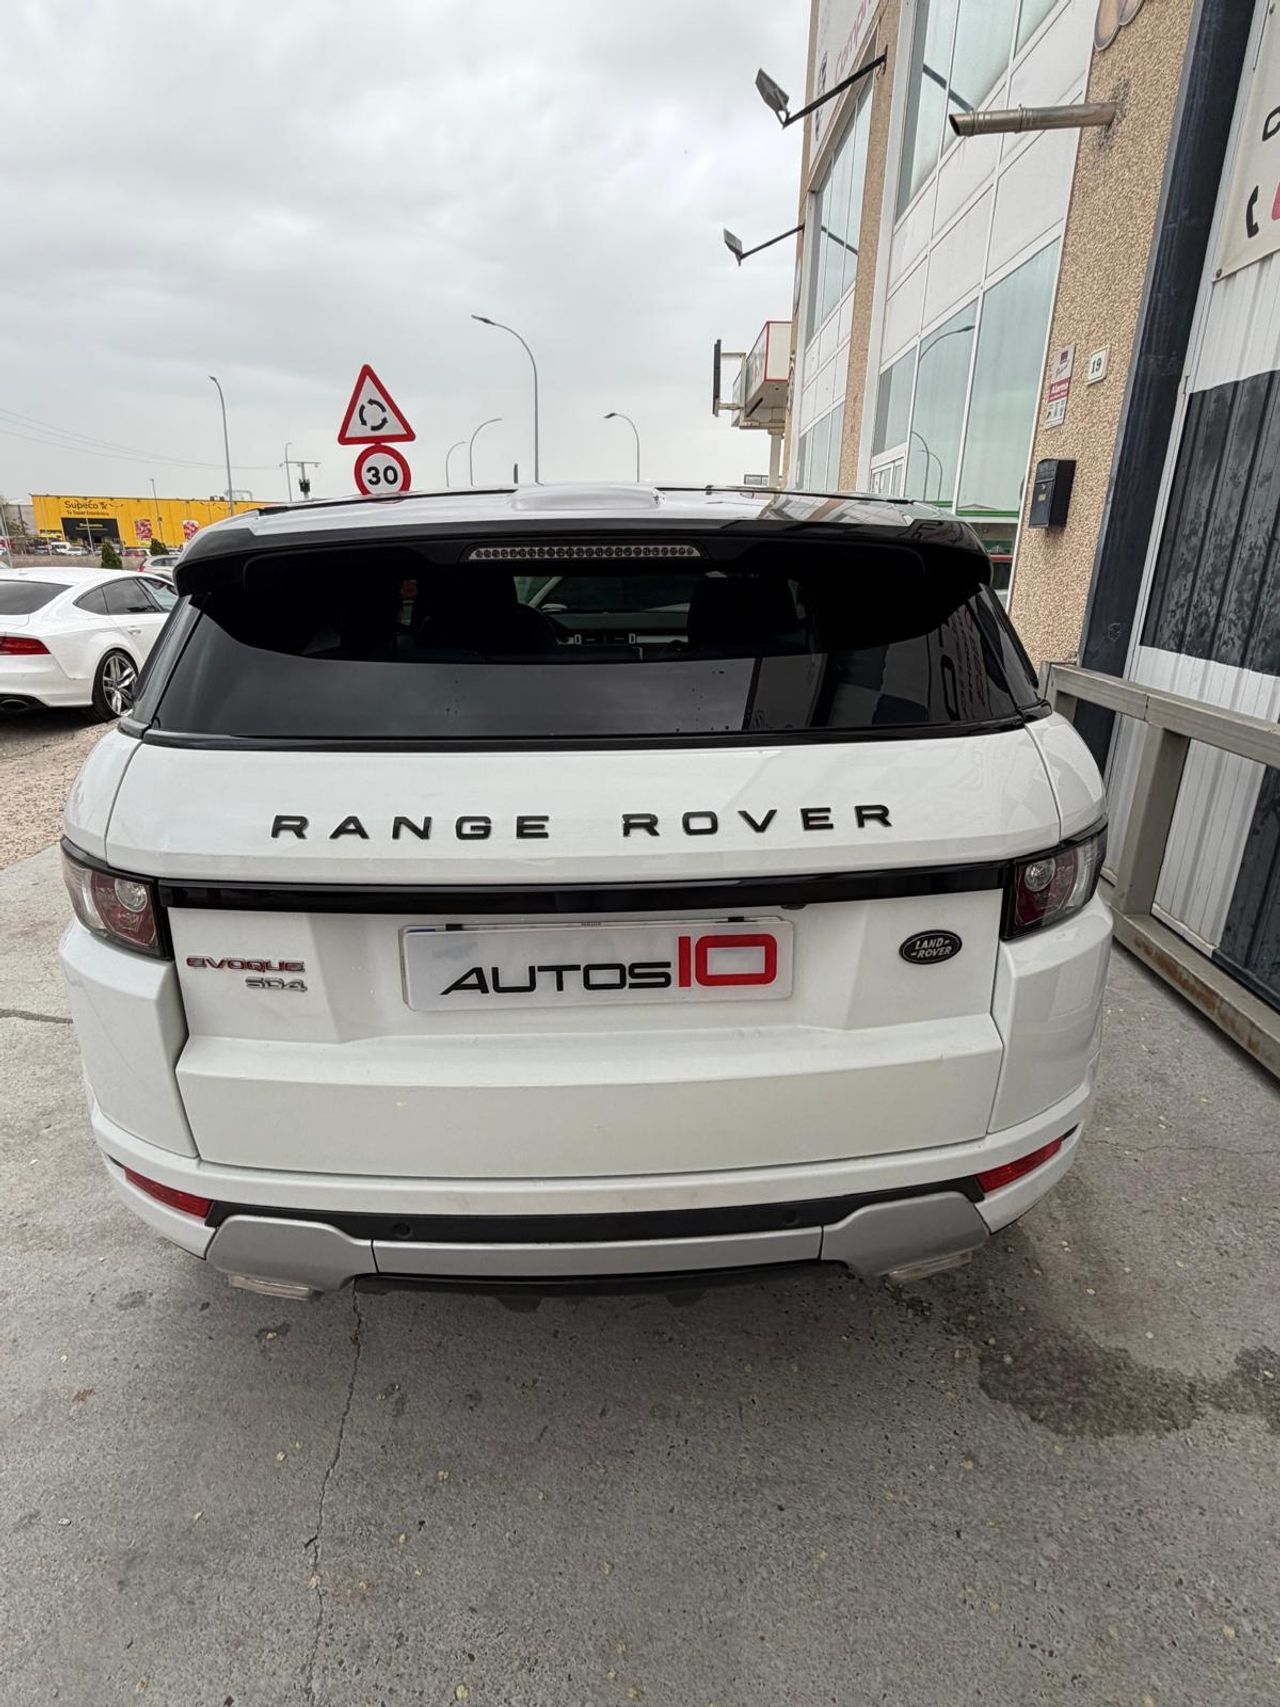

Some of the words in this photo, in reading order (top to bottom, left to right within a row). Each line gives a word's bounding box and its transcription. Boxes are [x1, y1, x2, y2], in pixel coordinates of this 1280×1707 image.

[1091, 357, 1102, 374] 19
[366, 465, 398, 485] 30
[64, 500, 98, 510] Supeco
[270, 814, 550, 840] RANGE
[622, 804, 893, 838] ROVER
[186, 957, 305, 973] EVOQUE
[245, 977, 308, 993] SD4
